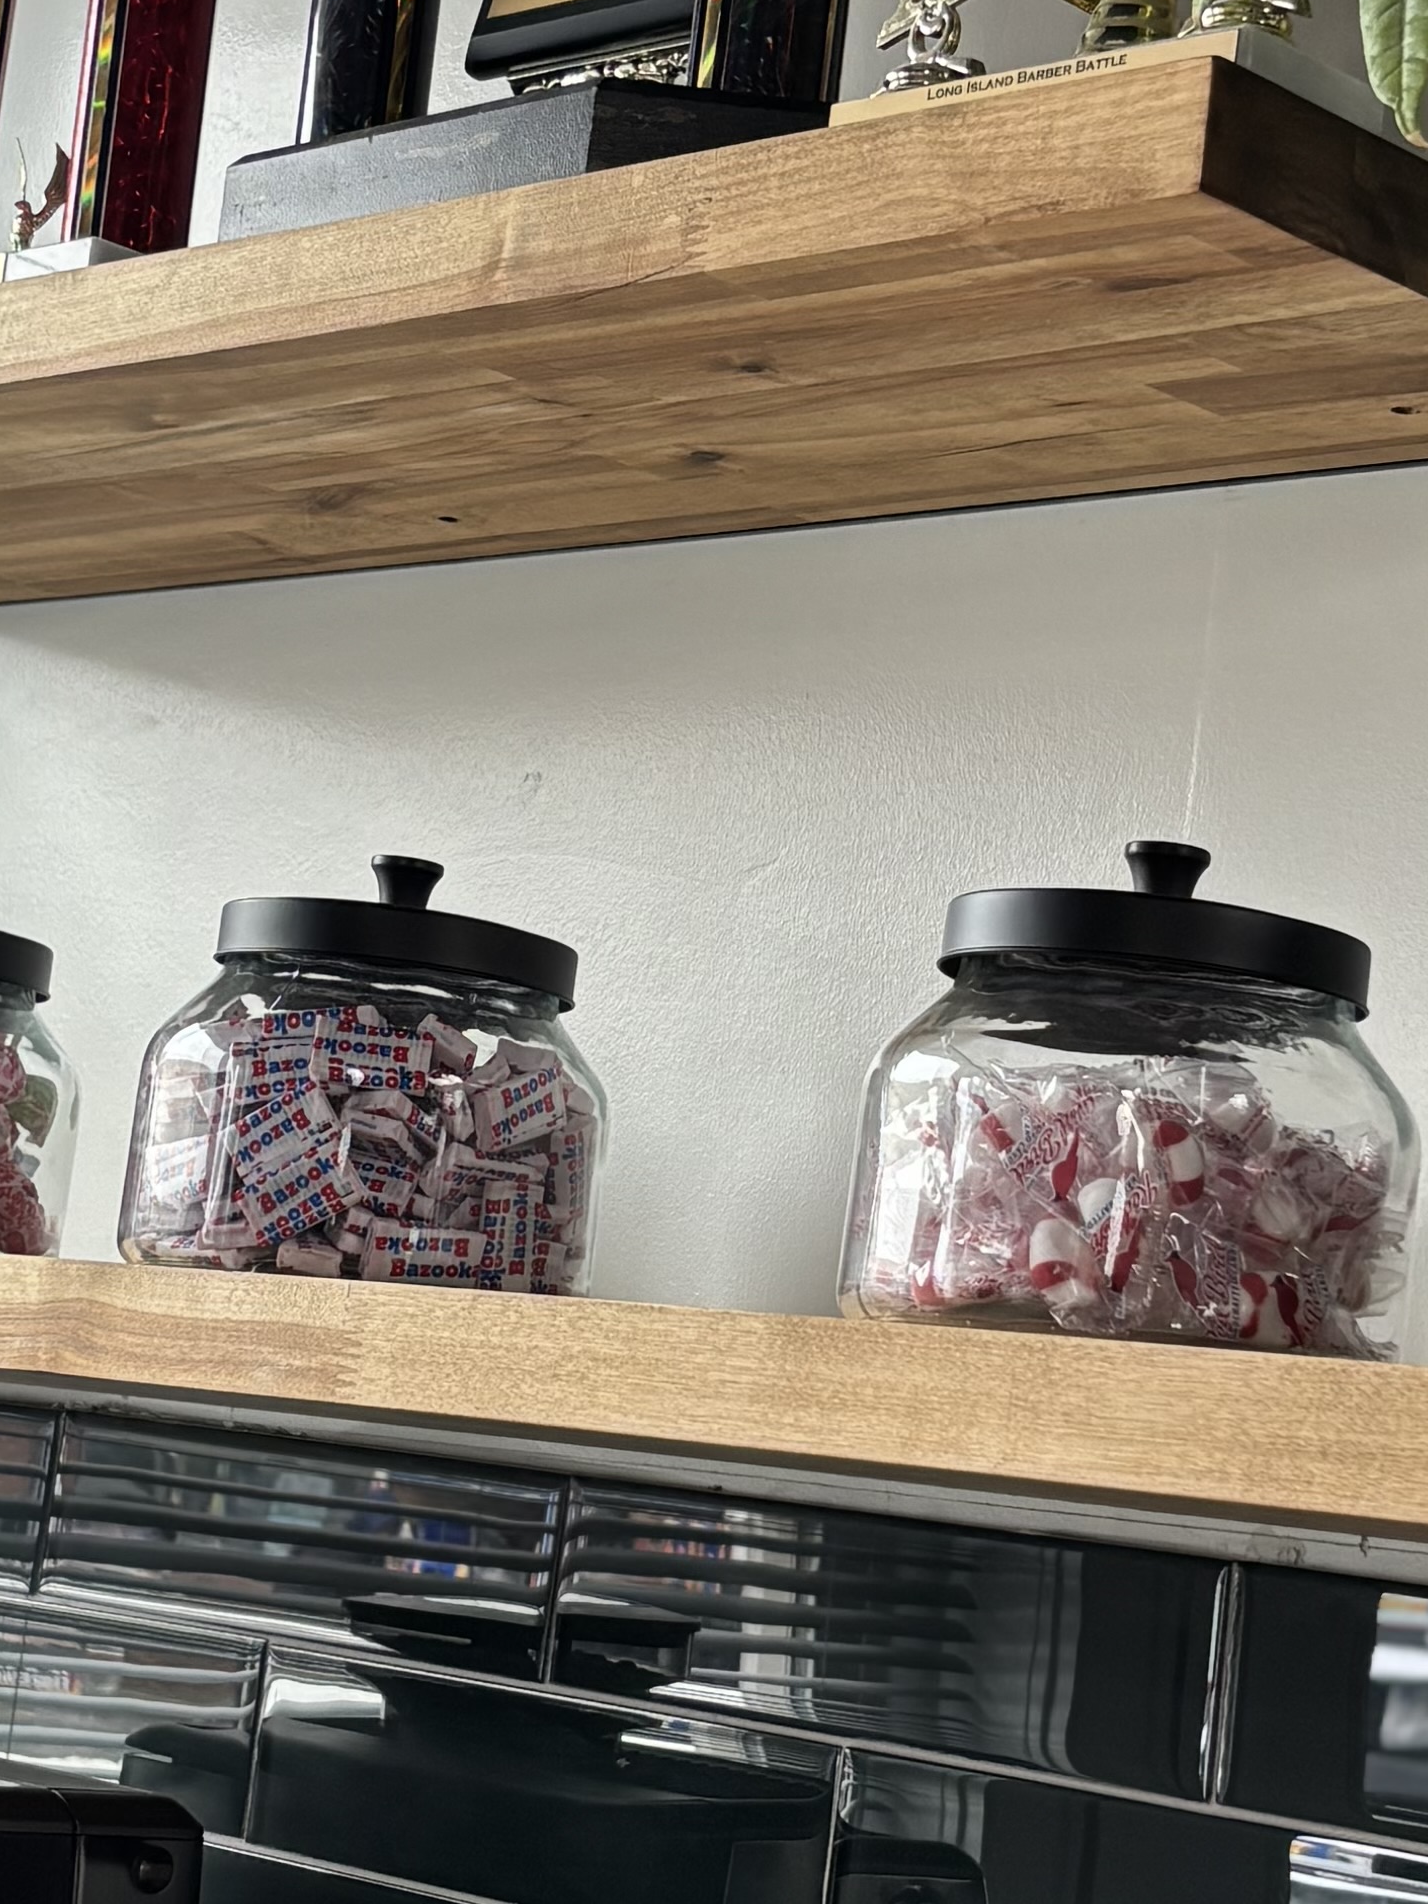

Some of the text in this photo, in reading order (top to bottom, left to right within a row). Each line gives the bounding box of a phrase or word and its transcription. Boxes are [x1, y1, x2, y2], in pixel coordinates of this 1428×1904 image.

[312, 1037, 409, 1064] Bazooka
[509, 1183, 530, 1276] Bazooka
[375, 1236, 470, 1258] Bazooka
